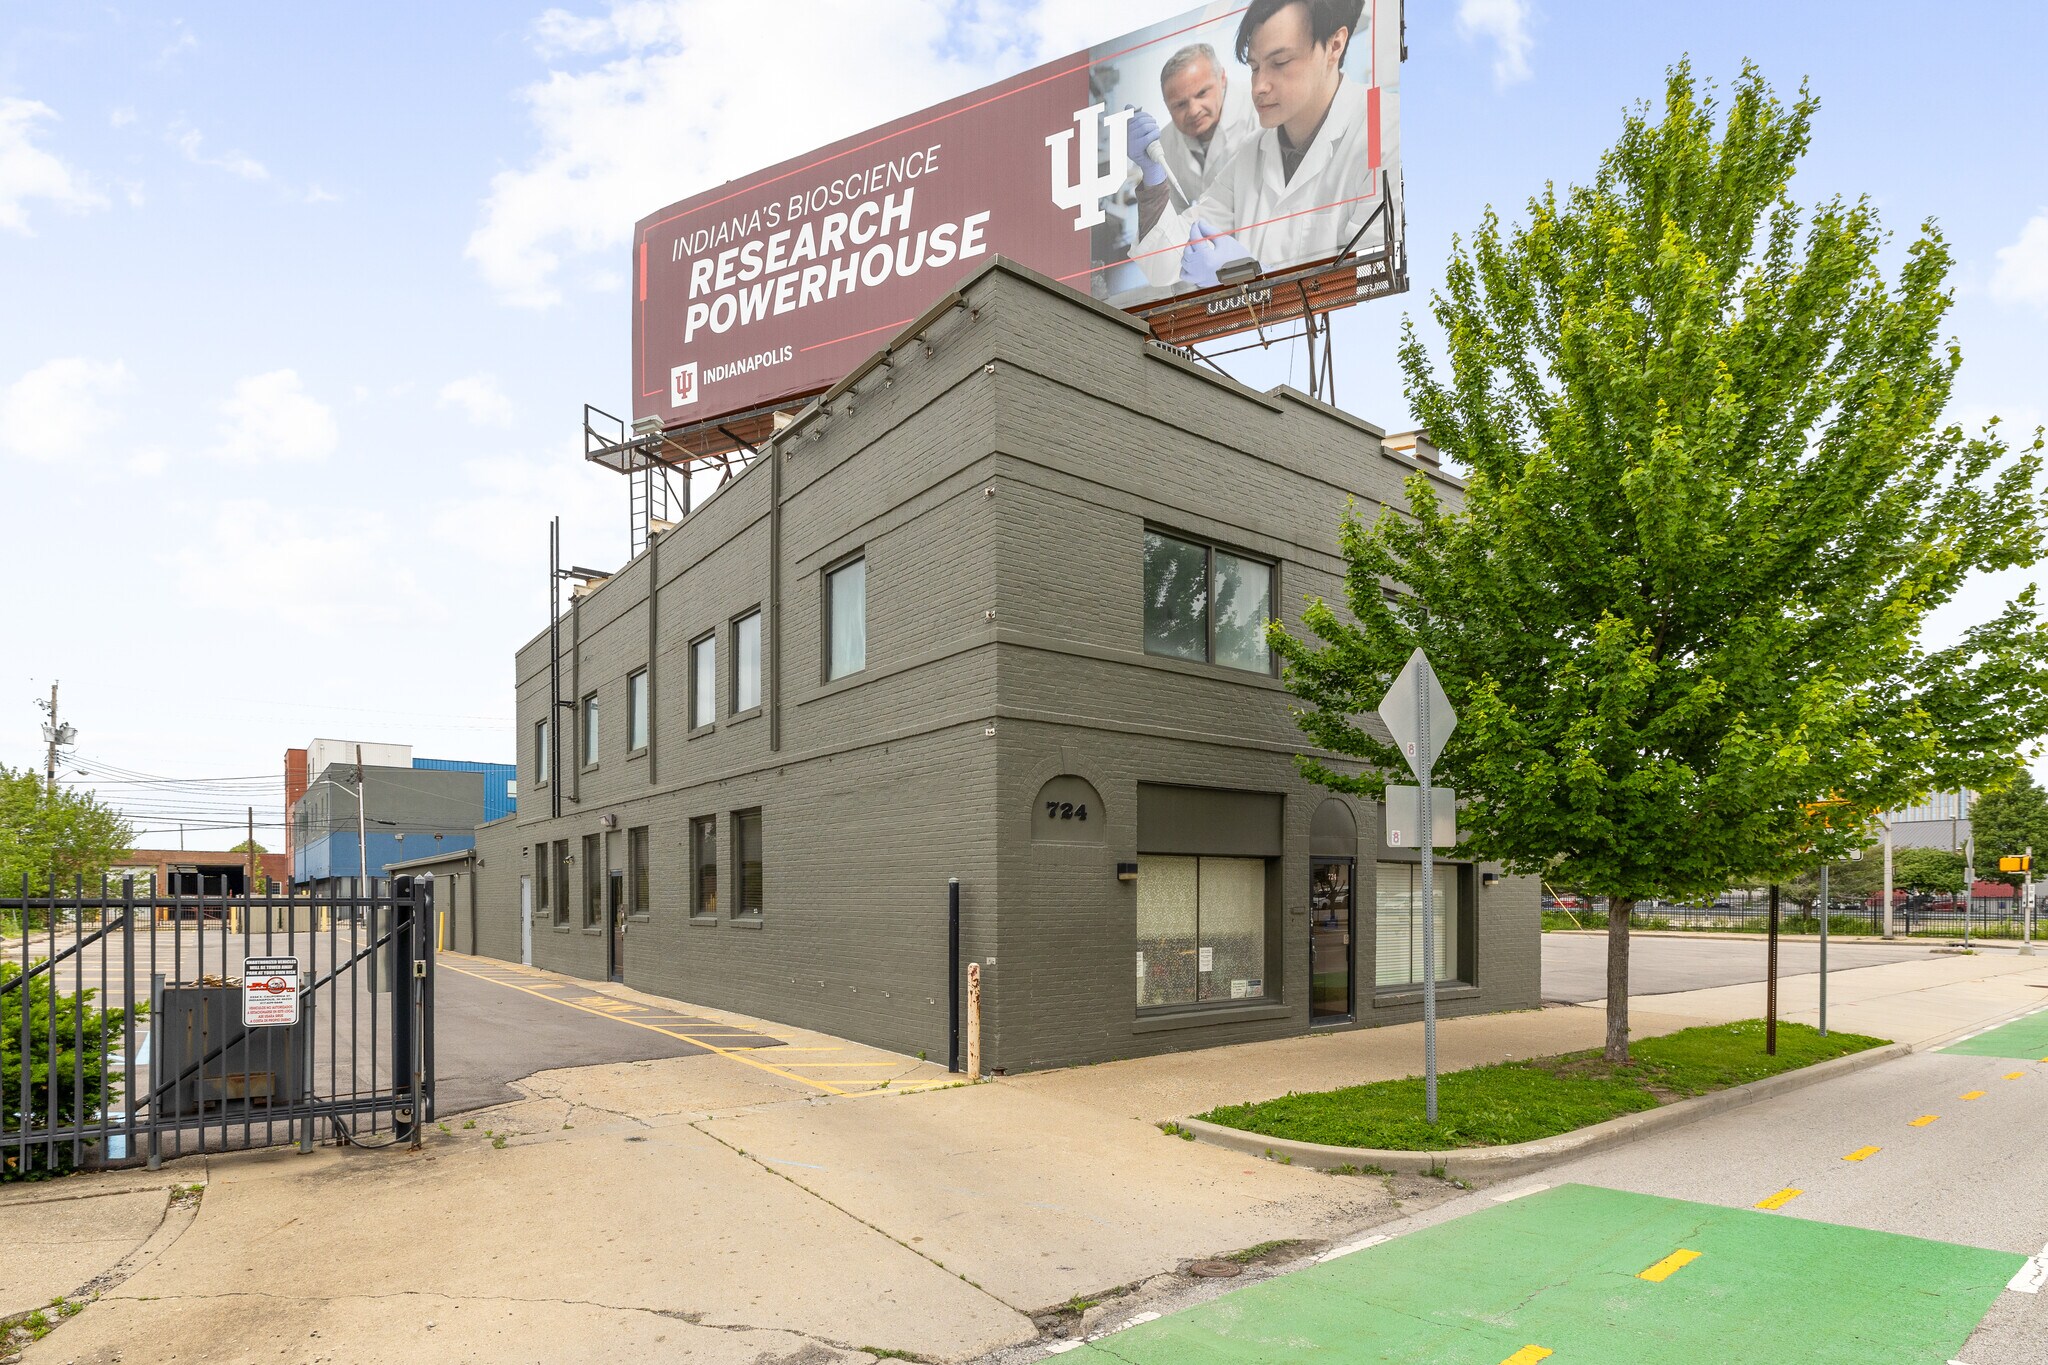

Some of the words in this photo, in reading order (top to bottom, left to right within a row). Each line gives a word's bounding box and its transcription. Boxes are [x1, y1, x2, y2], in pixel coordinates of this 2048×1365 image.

[672, 203, 782, 262] INDIANA'S
[787, 143, 942, 222] BIOSCIENCE
[688, 187, 915, 300] RESEARCH
[683, 210, 991, 344] POWERHOUSE
[703, 345, 793, 385] INDIANAPOLIS
[1046, 801, 1087, 821] 724
